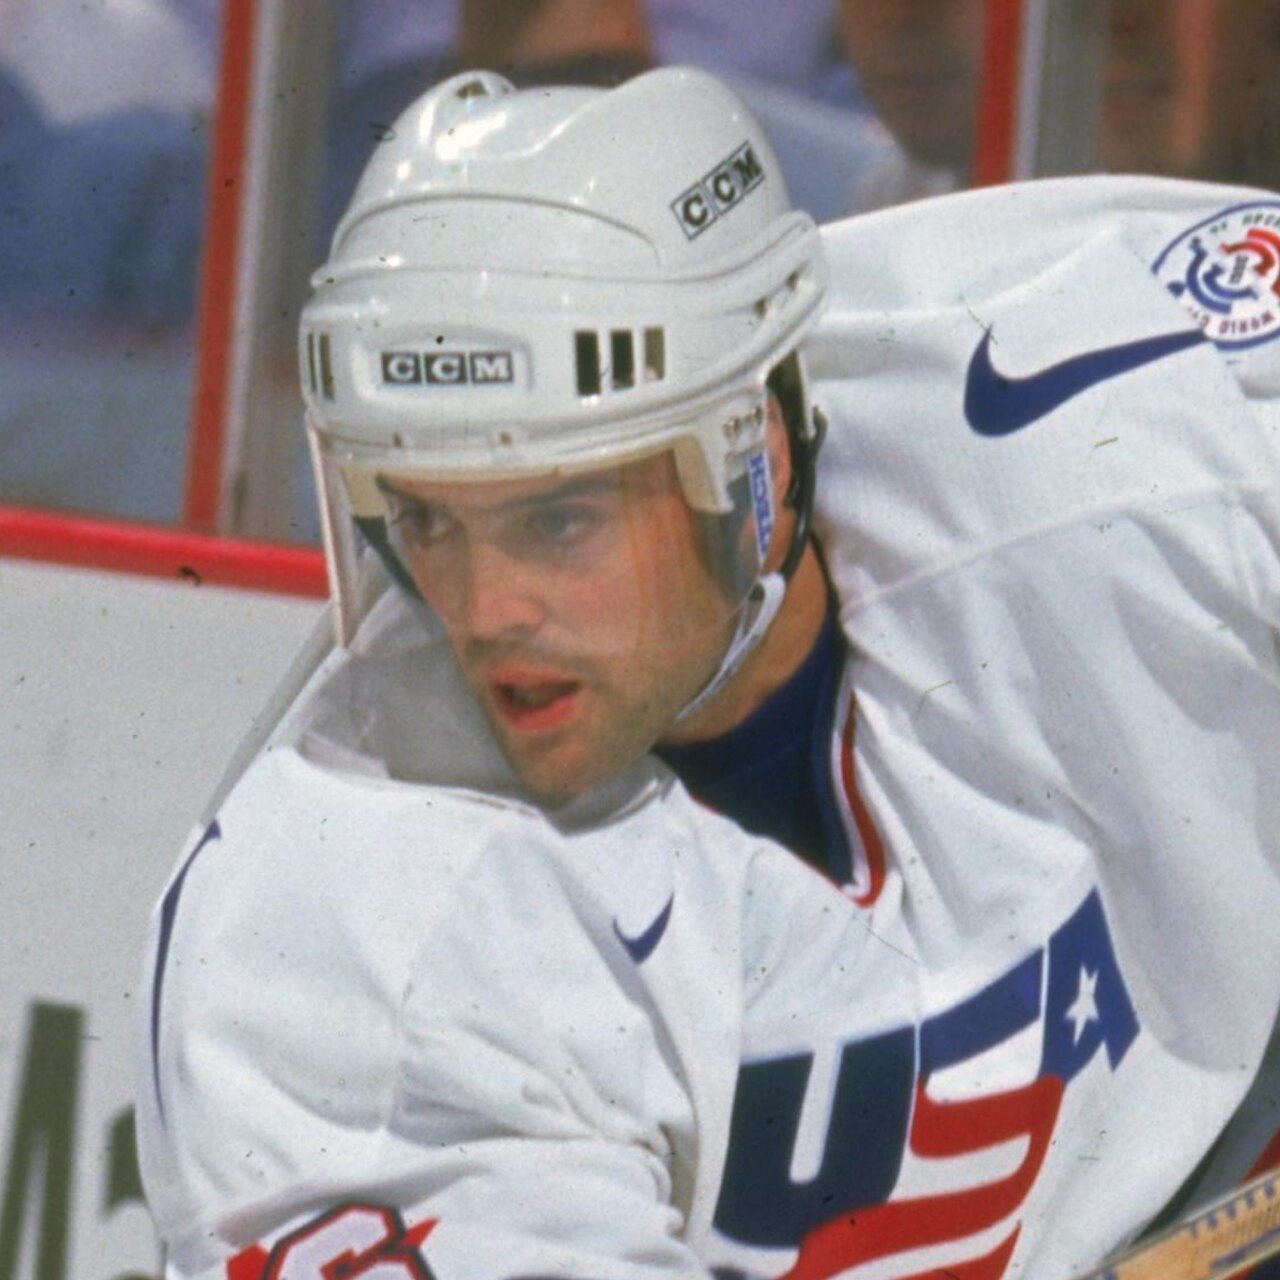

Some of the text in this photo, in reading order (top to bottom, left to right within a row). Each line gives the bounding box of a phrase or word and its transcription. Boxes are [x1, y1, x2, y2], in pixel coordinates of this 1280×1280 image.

[670, 140, 765, 241] CCM
[381, 351, 514, 385] CCM
[713, 886, 1141, 1275] USA
